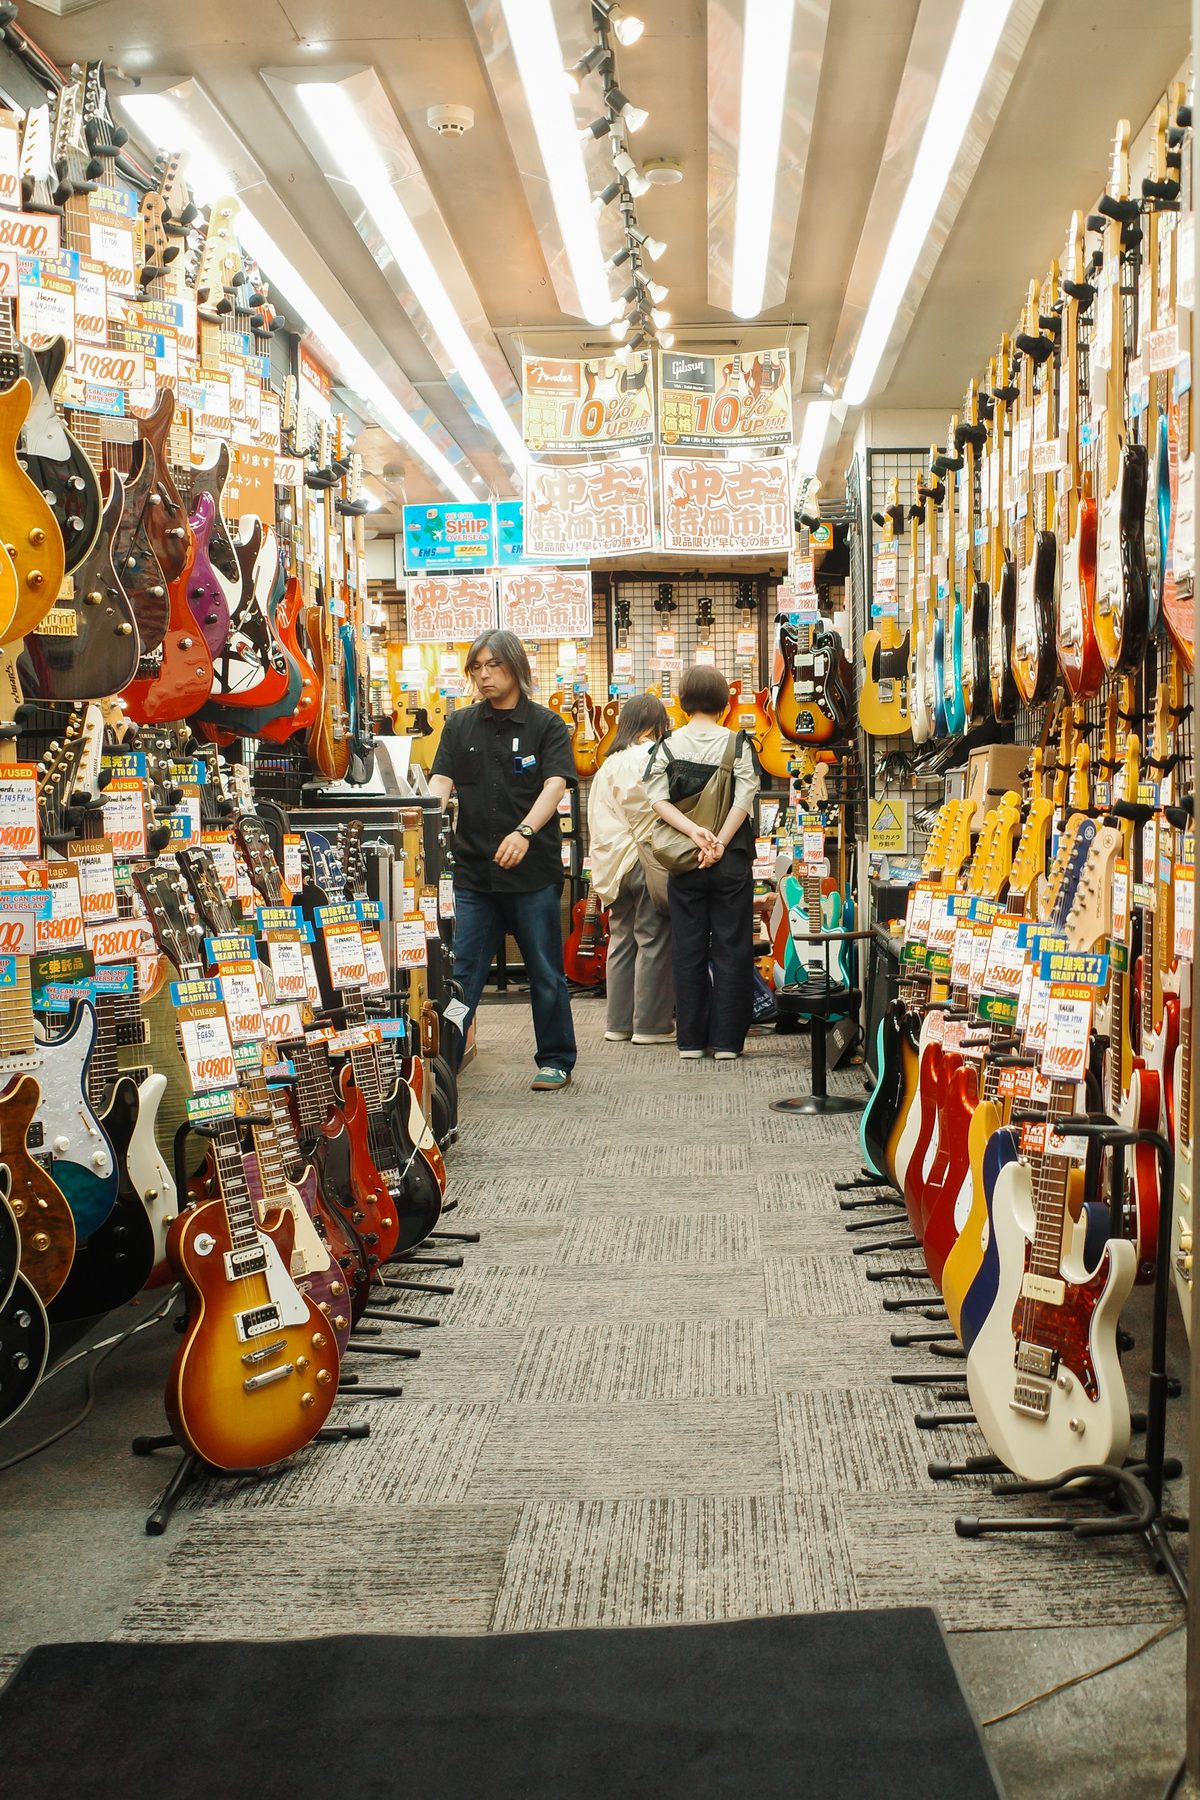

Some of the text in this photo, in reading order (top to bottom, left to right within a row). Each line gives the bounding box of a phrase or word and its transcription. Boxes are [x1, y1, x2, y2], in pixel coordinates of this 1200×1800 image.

[93, 211, 123, 226] Vintage
[80, 353, 135, 381] 79800
[672, 360, 705, 380] Gibson
[530, 366, 574, 384] Fender
[560, 398, 632, 438] 10%
[695, 393, 767, 434] 10%
[241, 452, 271, 468] ります
[543, 465, 630, 512] 中古
[682, 462, 771, 506] 中古
[446, 519, 487, 533] SHIP
[532, 505, 645, 540] 特価市!!
[670, 504, 785, 536] 特価市!!
[418, 548, 437, 557] EMS
[419, 579, 484, 608] 中古
[514, 575, 581, 605] 中古
[414, 606, 490, 631] 特価市!!
[507, 604, 585, 627] 特価市!!
[126, 768, 136, 776] GO
[72, 842, 104, 853] Vintage
[150, 872, 168, 885] Greco
[264, 920, 281, 928] READY
[322, 917, 340, 925] READY
[93, 929, 142, 956] 138000
[273, 932, 293, 941] Vintage
[215, 950, 250, 961] READY TO GO
[38, 958, 84, 975] ご委託品
[1050, 955, 1102, 972] 調整完了!
[90, 975, 125, 983] OVERSEAS!
[338, 964, 365, 979] 79800
[992, 965, 1022, 985] 55000
[1051, 971, 1098, 983] READY TO GO
[278, 976, 304, 991] 49800
[180, 992, 217, 1004] READY TO GO
[188, 1007, 217, 1017] Vintage
[197, 1030, 214, 1039] EG650
[197, 1056, 233, 1077] 49800
[1016, 1070, 1032, 1080] TAX
[1016, 1080, 1030, 1088] FREE
[1024, 1124, 1044, 1136] TAX
[1024, 1135, 1043, 1145] FREE
